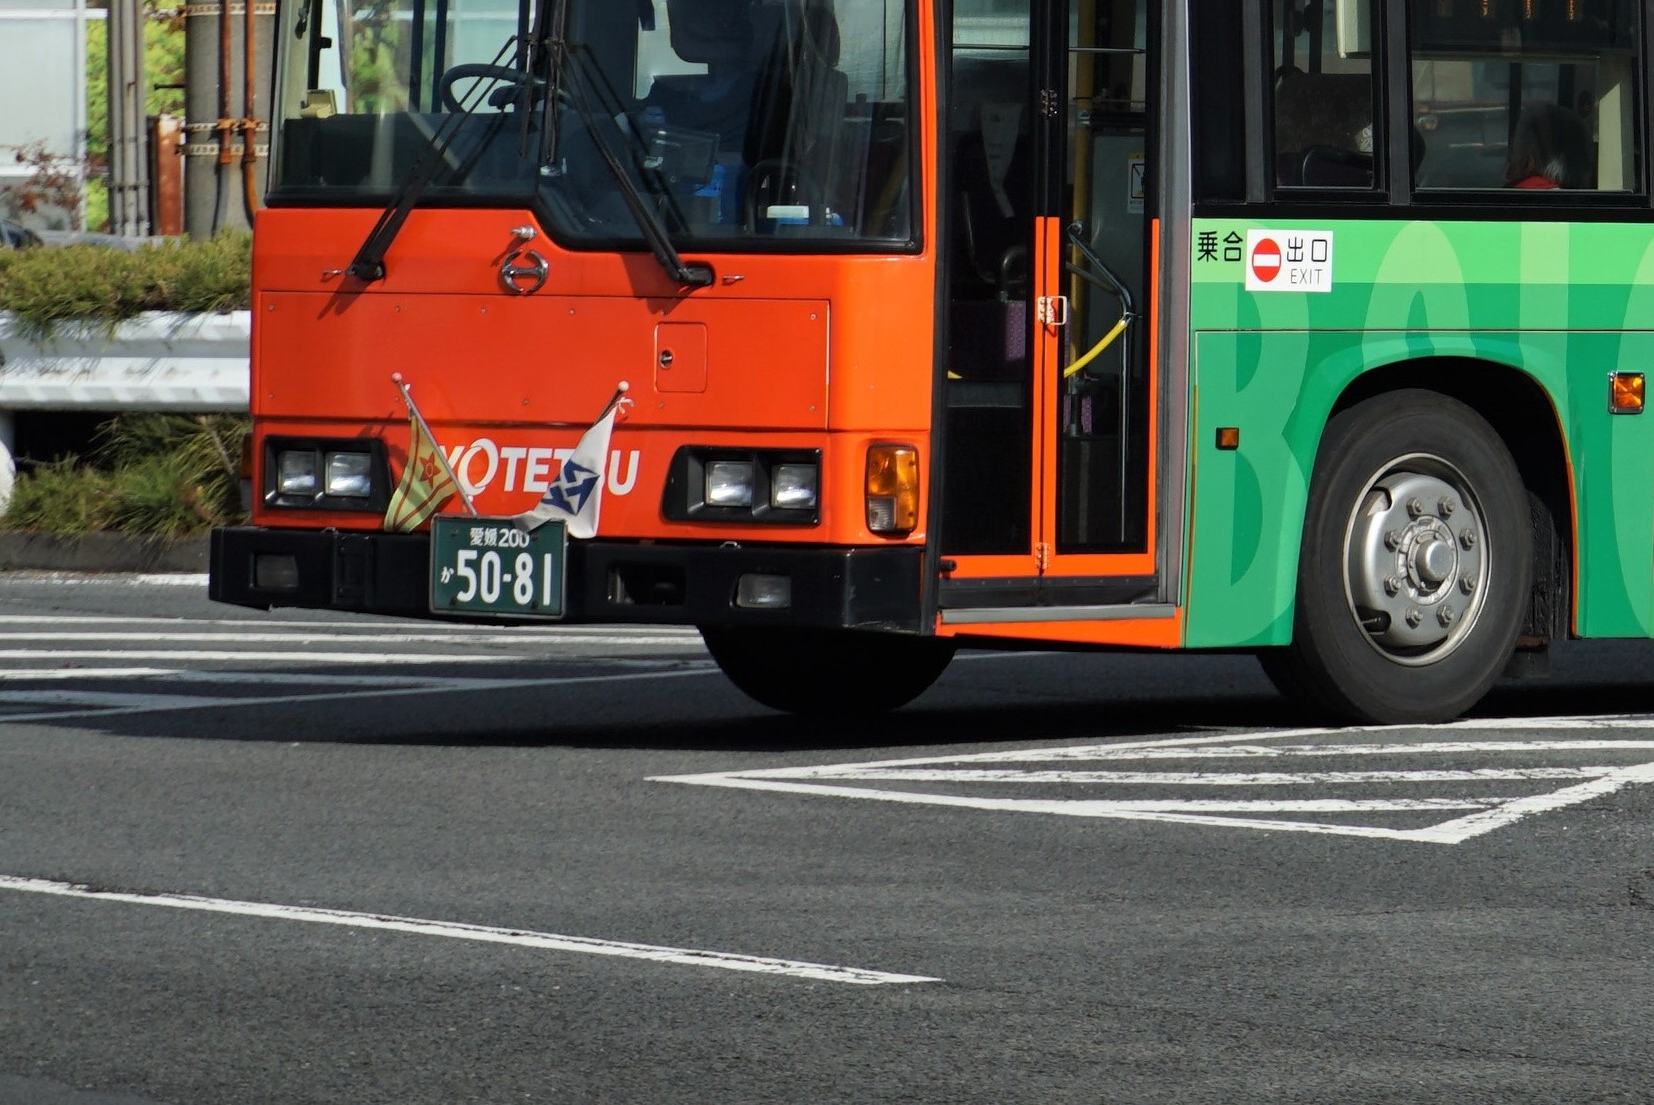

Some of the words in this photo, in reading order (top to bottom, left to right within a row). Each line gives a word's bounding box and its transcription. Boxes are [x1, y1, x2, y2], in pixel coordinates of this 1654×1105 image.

[1197, 230, 1244, 263] 乗合
[1286, 236, 1328, 263] 出口
[1290, 268, 1323, 285] EXIT
[440, 566, 454, 584] か
